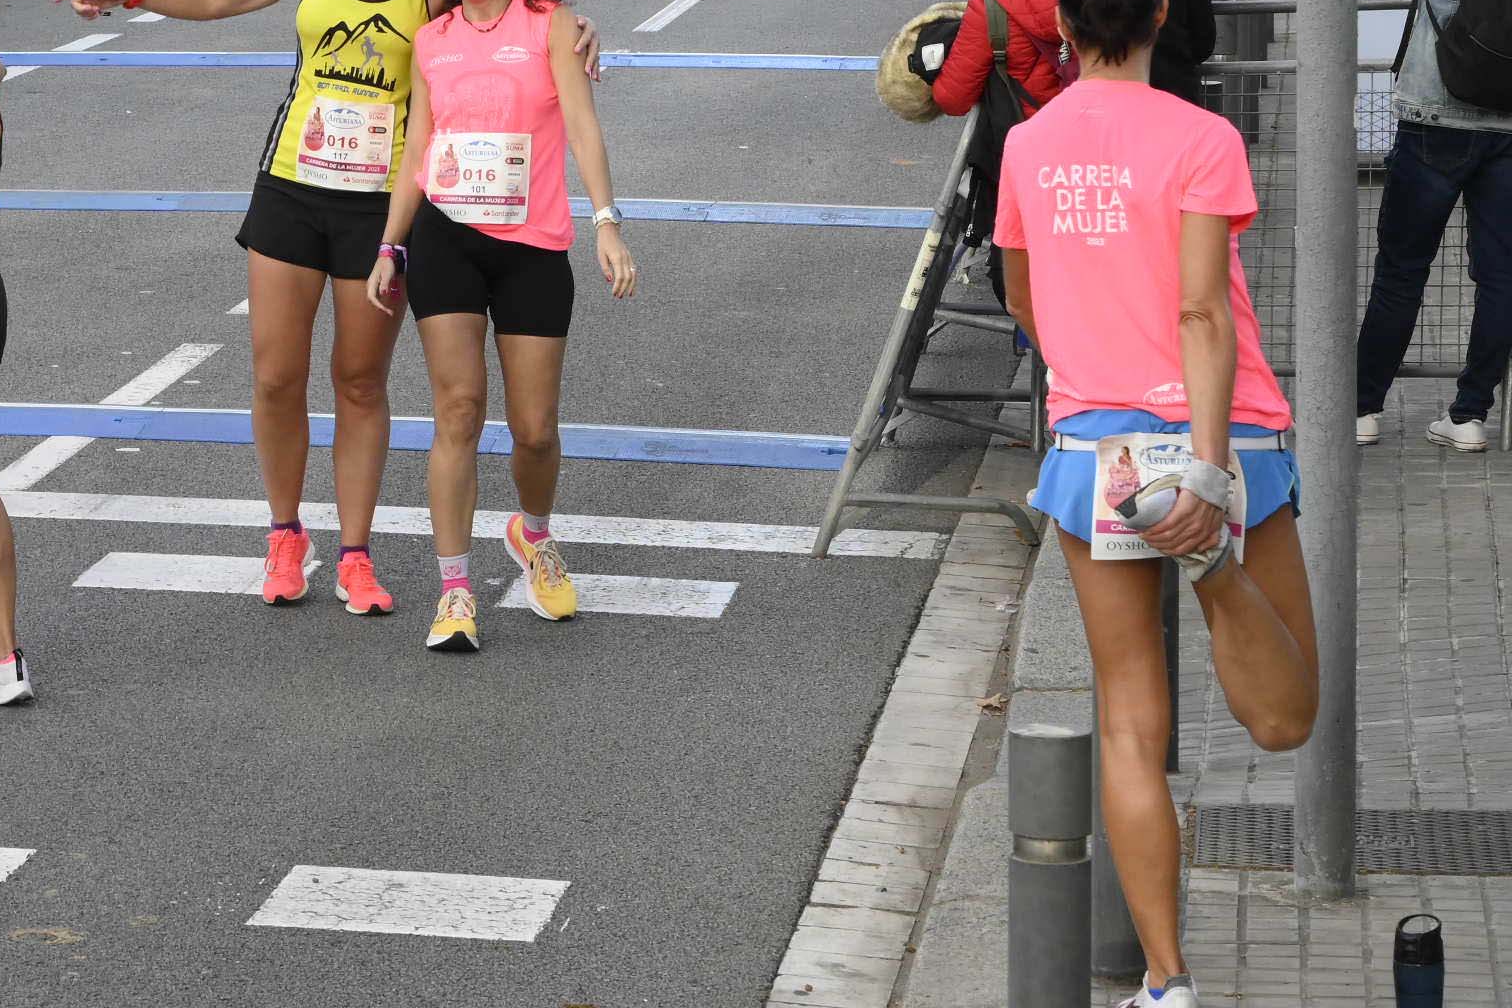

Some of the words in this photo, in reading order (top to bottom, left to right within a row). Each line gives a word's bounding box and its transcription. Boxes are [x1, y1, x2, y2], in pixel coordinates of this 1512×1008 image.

[328, 134, 358, 149] 016
[333, 152, 348, 161] 117
[462, 168, 496, 182] 016
[471, 185, 486, 194] 101
[440, 195, 466, 203] CARRERA
[1056, 189, 1086, 211] DE
[1095, 188, 1124, 210] LA
[1052, 211, 1129, 235] MUJER
